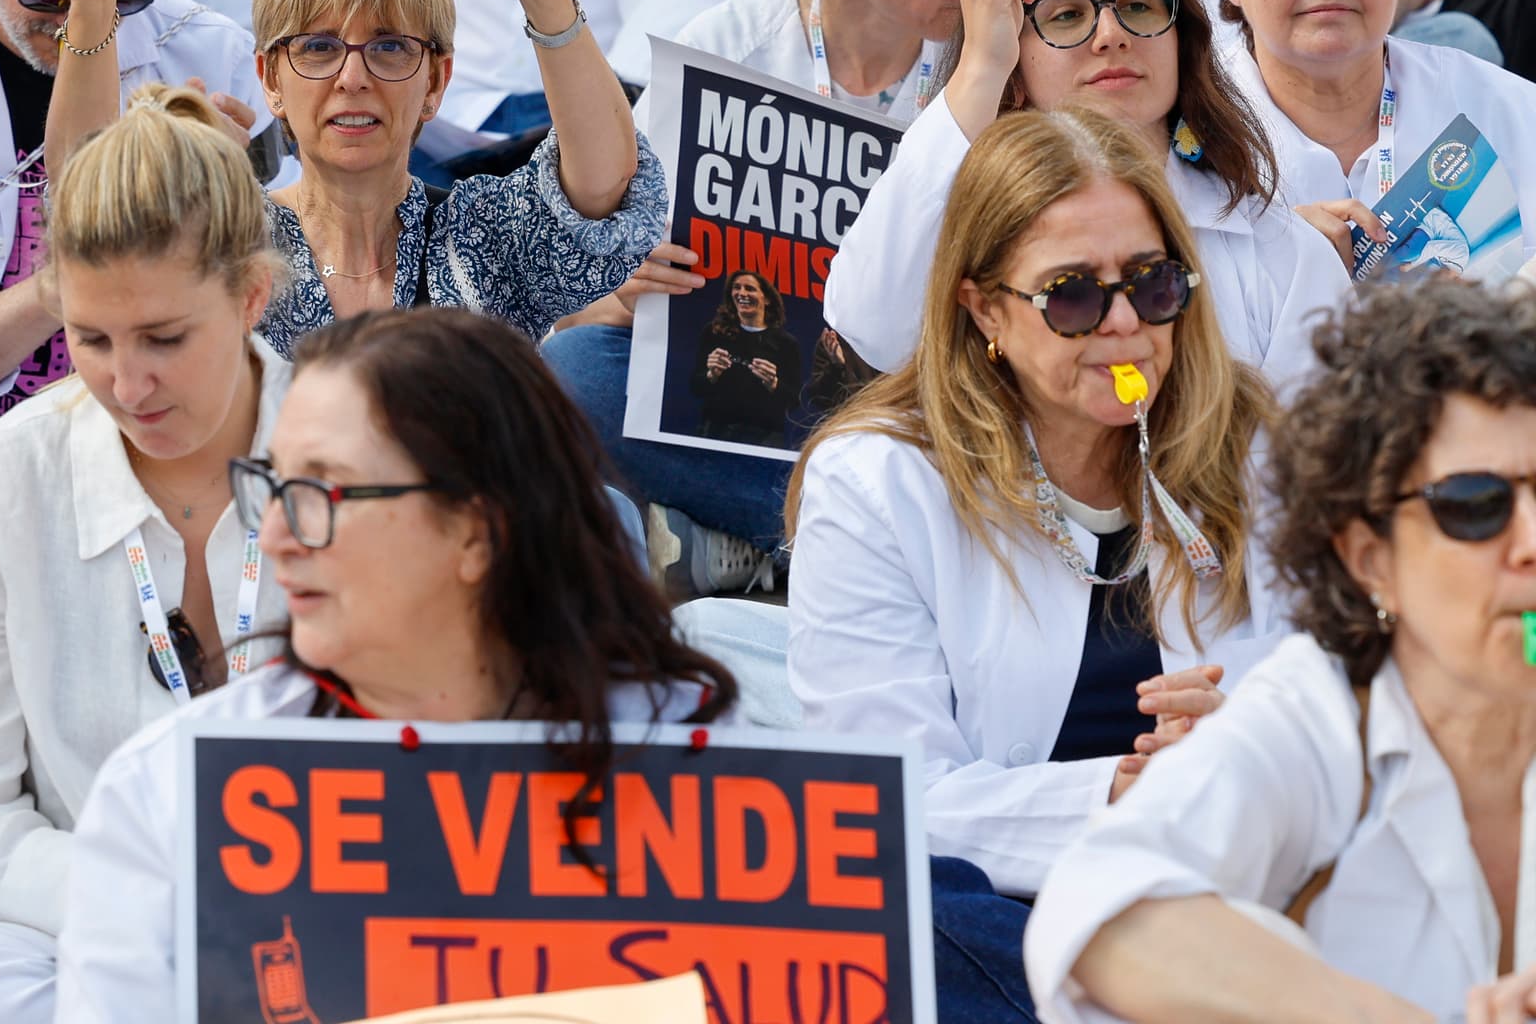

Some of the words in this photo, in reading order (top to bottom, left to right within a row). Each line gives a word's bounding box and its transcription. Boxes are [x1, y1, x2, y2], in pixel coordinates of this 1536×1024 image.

[1357, 232, 1399, 281] DIGNIDAD
[219, 765, 389, 894] SE
[427, 771, 885, 910] VENDE
